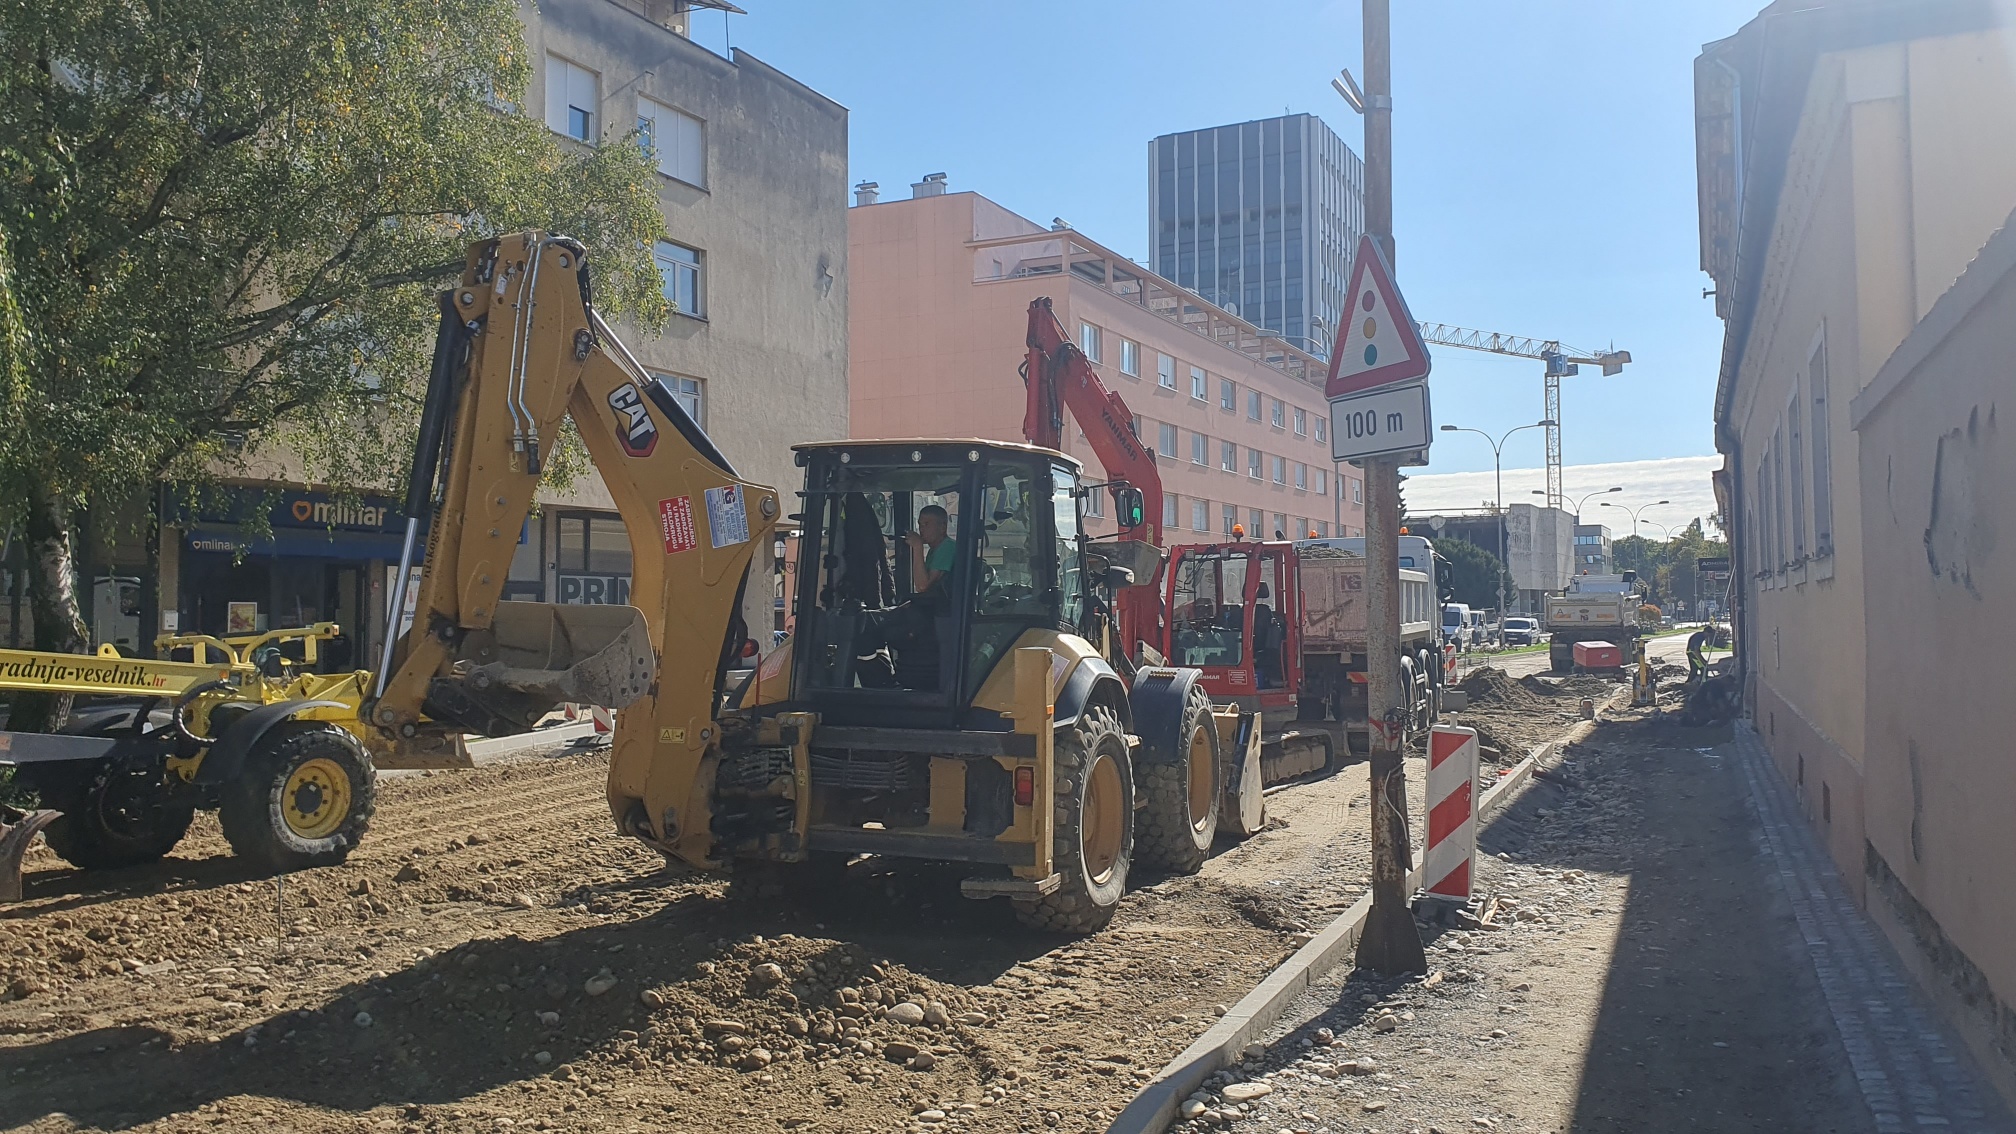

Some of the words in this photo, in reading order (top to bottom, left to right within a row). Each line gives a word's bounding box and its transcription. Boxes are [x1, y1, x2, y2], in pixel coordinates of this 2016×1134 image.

[609, 384, 656, 441] CAT
[1345, 409, 1377, 439] 100
[1386, 412, 1403, 433] m
[1102, 406, 1137, 461] YANMAR
[313, 500, 388, 526] mlinar
[678, 497, 684, 507] SE
[661, 513, 671, 542] STROJA
[665, 502, 678, 550] DJELOKRUGU
[673, 512, 684, 544] RADNOM
[684, 499, 696, 546] ZABRANJENO
